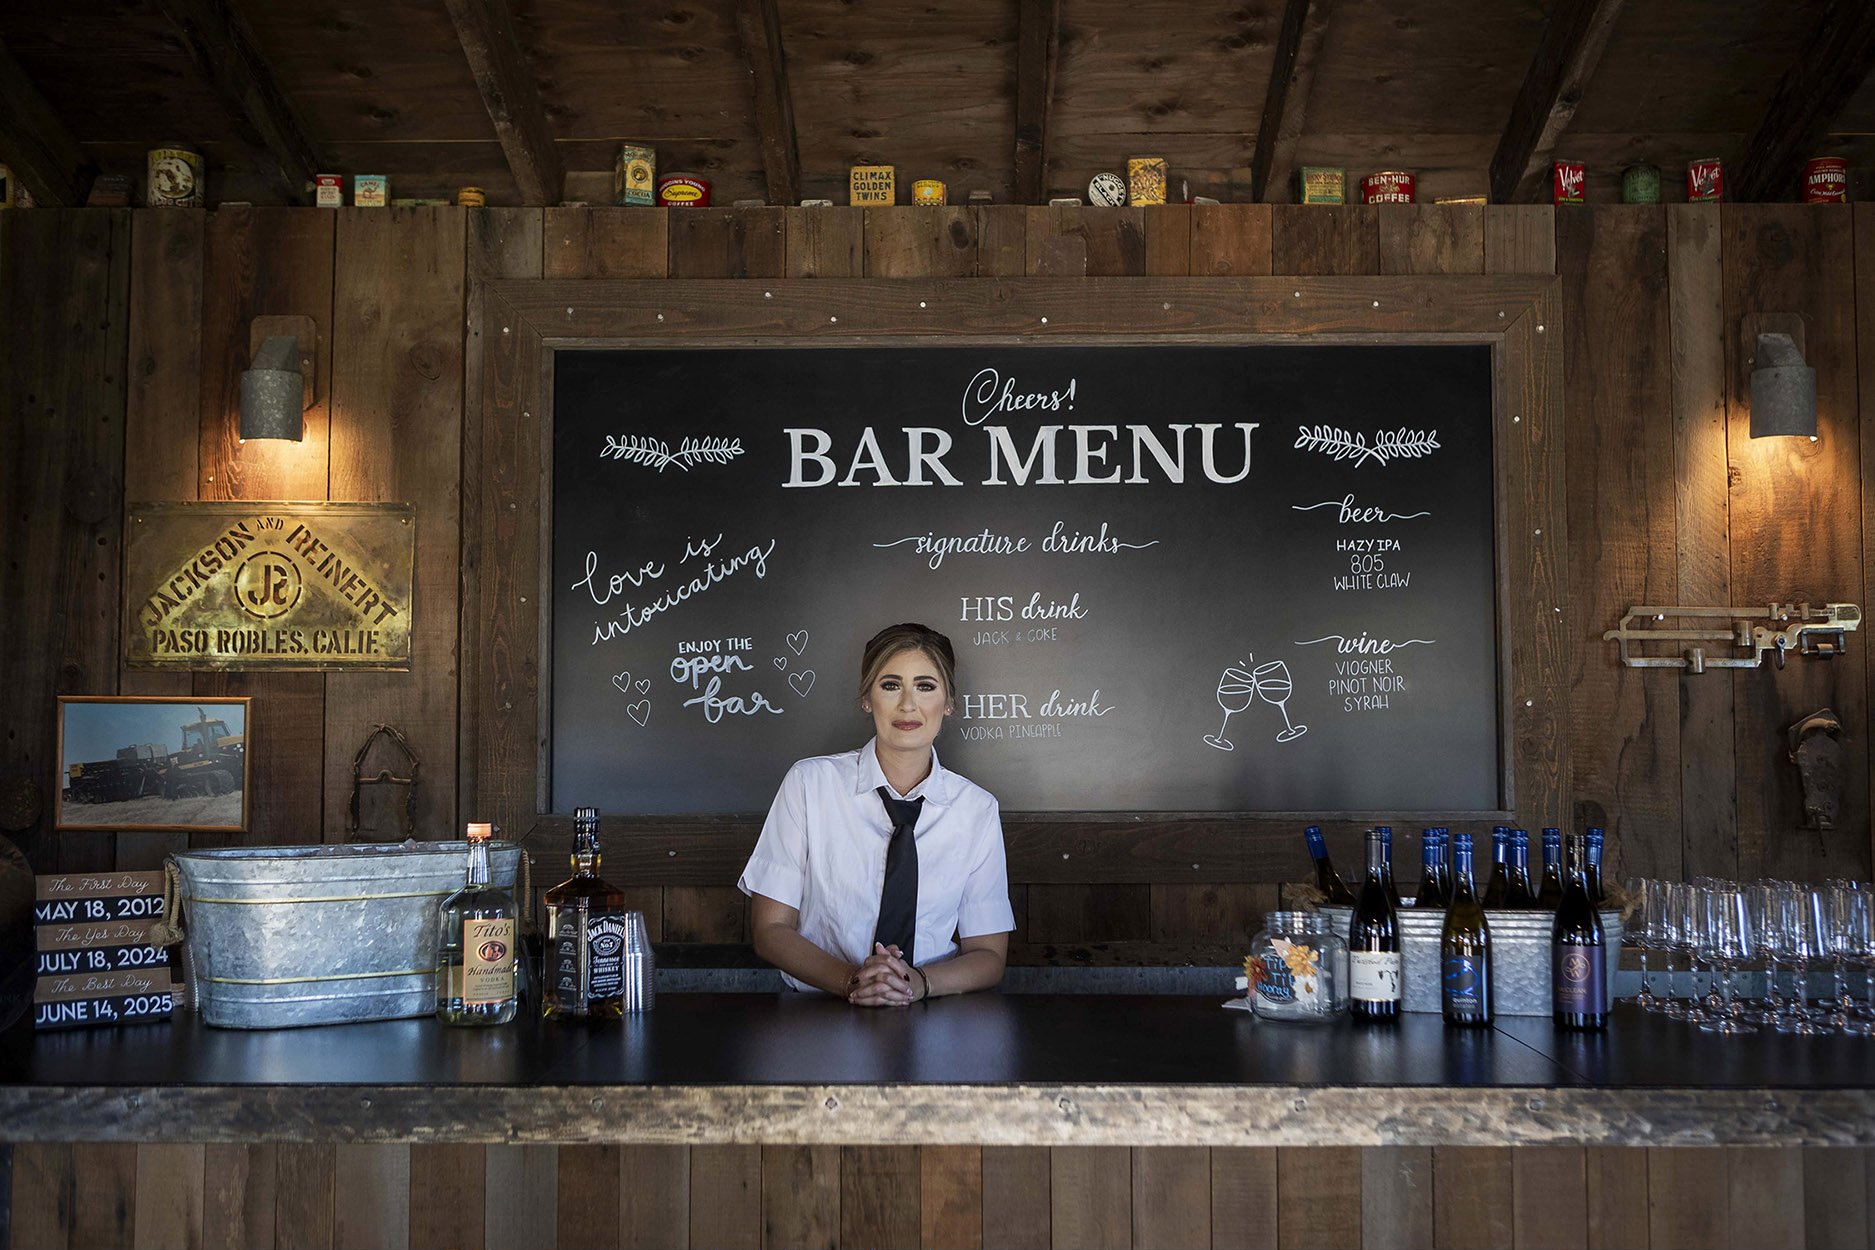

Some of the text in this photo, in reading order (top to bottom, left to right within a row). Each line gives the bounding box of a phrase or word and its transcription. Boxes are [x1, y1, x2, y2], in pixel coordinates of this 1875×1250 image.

[853, 171, 891, 180] CLIMAX
[853, 181, 891, 190] GOLDEN
[1368, 175, 1410, 186] BEN-HUR
[856, 191, 887, 200] TWINS
[1094, 181, 1116, 206] BLACK
[1368, 193, 1410, 204] COFFEE
[963, 368, 1076, 425] Cheers!
[782, 422, 1260, 488] BAR MENU
[680, 533, 722, 564] is
[915, 520, 1121, 570] signature drinks
[1336, 539, 1401, 552] HAZY IPA
[146, 517, 398, 628] JACKSON AND REINERT
[1350, 553, 1384, 574] 805
[1333, 571, 1411, 591] WHITE CLAW
[592, 539, 775, 645] intoxicating
[960, 592, 1089, 621] HIS drink
[152, 629, 380, 656] PASO ROBLES, CALIF.
[679, 637, 752, 653] ENJOY THE
[973, 631, 1009, 646] JACK
[1027, 627, 1058, 643] COKE
[670, 655, 754, 690] open
[1335, 658, 1394, 676] VIOGNER
[1328, 675, 1406, 695] PINOT NOIR
[683, 675, 784, 723] bar
[963, 689, 1115, 719] HER drink
[1343, 694, 1389, 713] SYRAH
[960, 723, 1061, 741] VODKA PINEAPPLE
[49, 875, 150, 894] The First Day
[35, 896, 165, 920] MAY 18, 2012
[55, 925, 146, 946] The Yes Day
[587, 922, 602, 942] JACK
[37, 946, 169, 973] JULY 18, 2024
[51, 974, 153, 993] The Best Day
[36, 994, 173, 1023] JUNE 14, 2025
